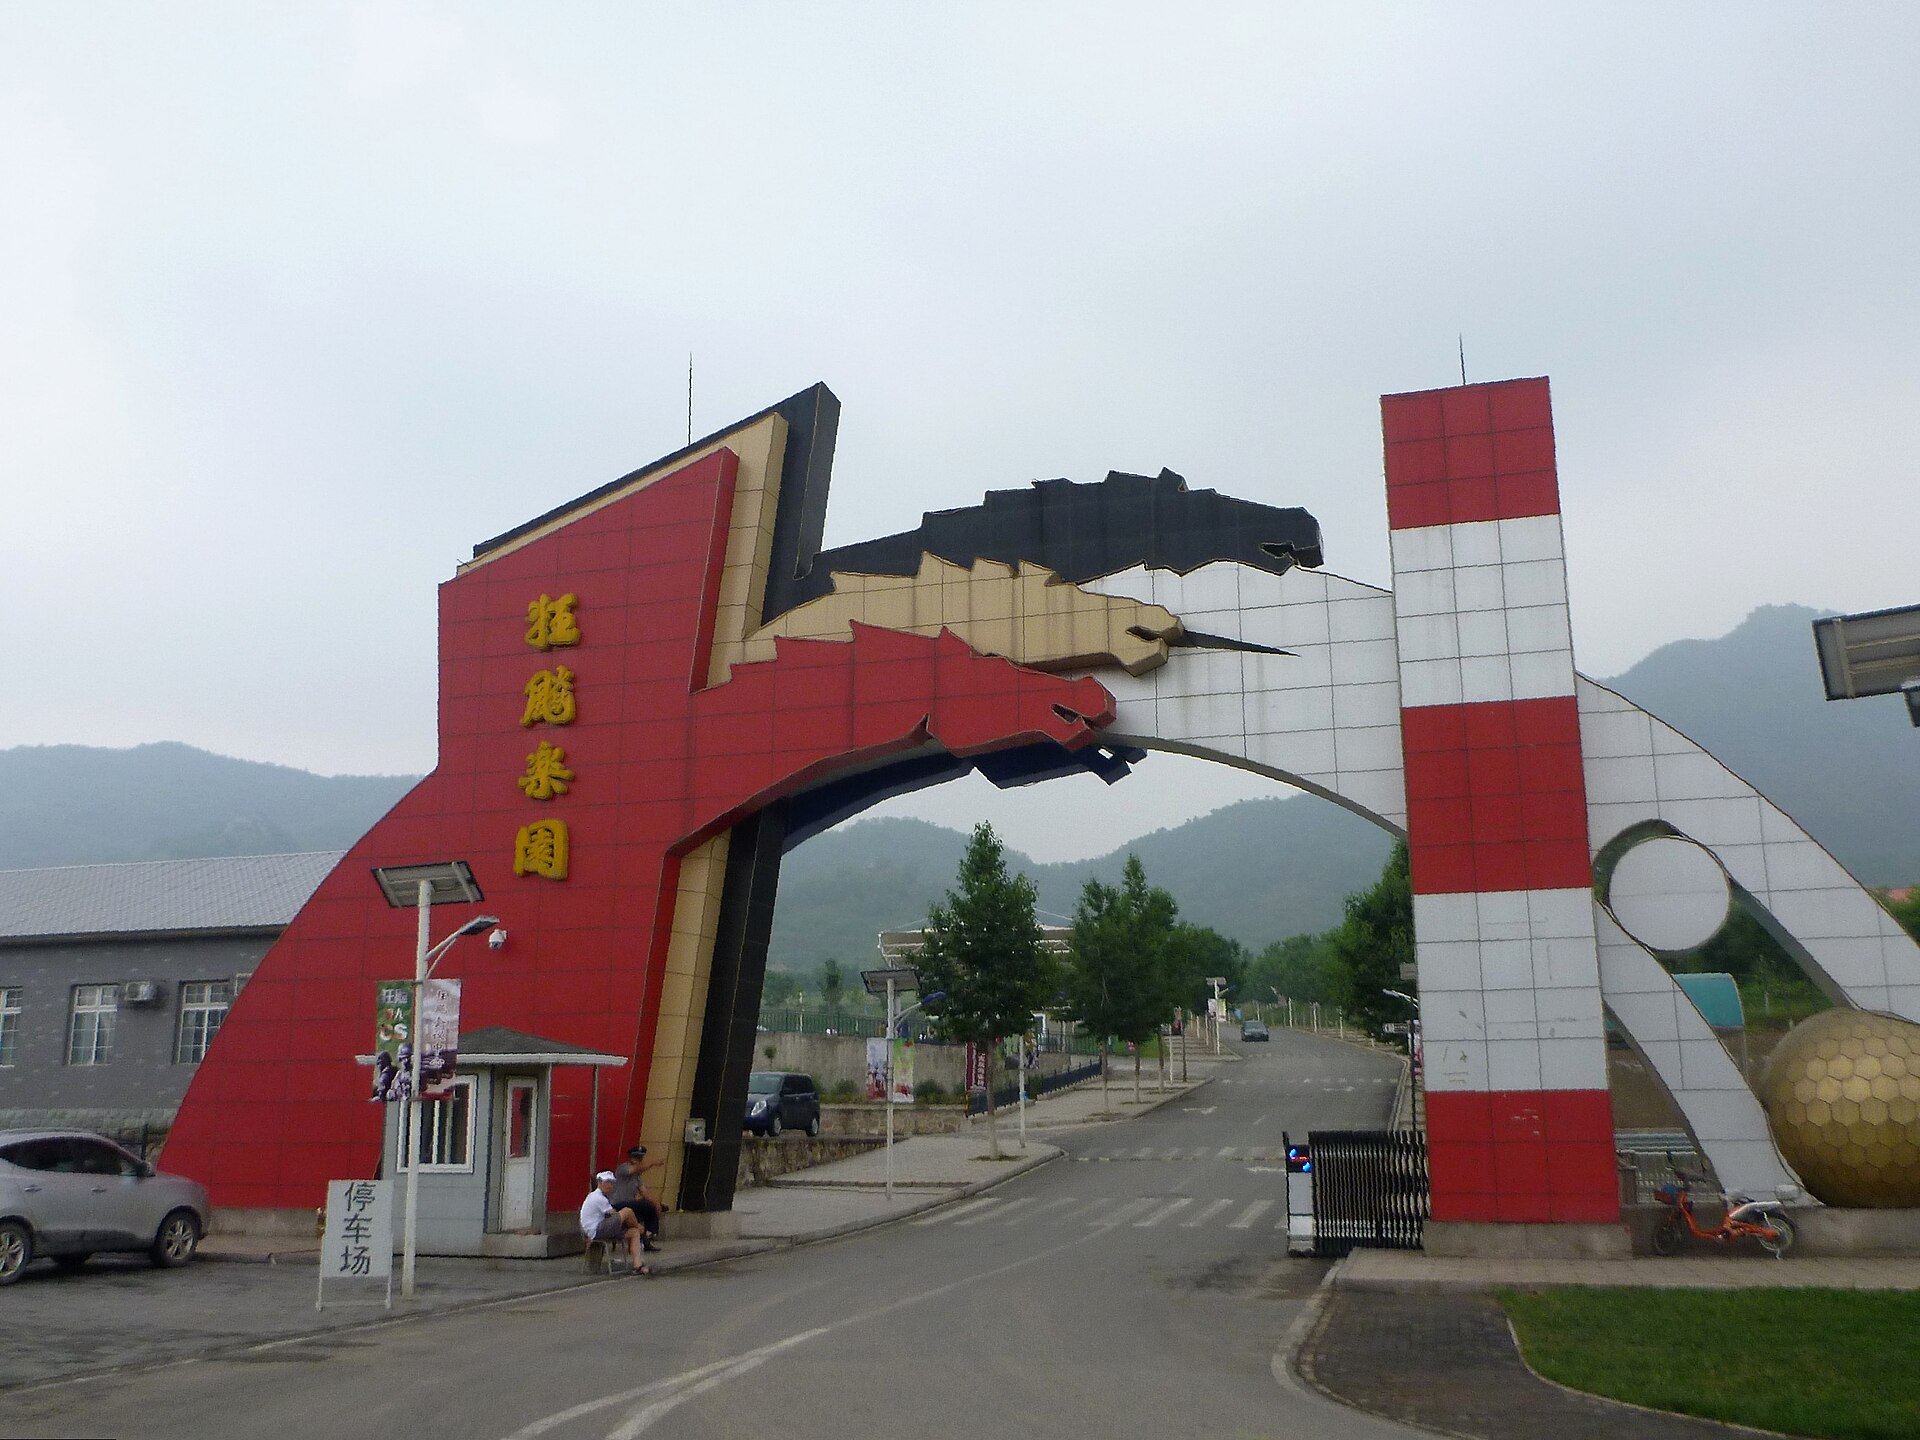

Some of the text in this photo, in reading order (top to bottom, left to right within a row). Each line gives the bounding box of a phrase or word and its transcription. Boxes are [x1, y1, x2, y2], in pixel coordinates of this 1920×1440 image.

[380, 1023, 408, 1041] CS
[340, 1182, 376, 1275] 停车场
